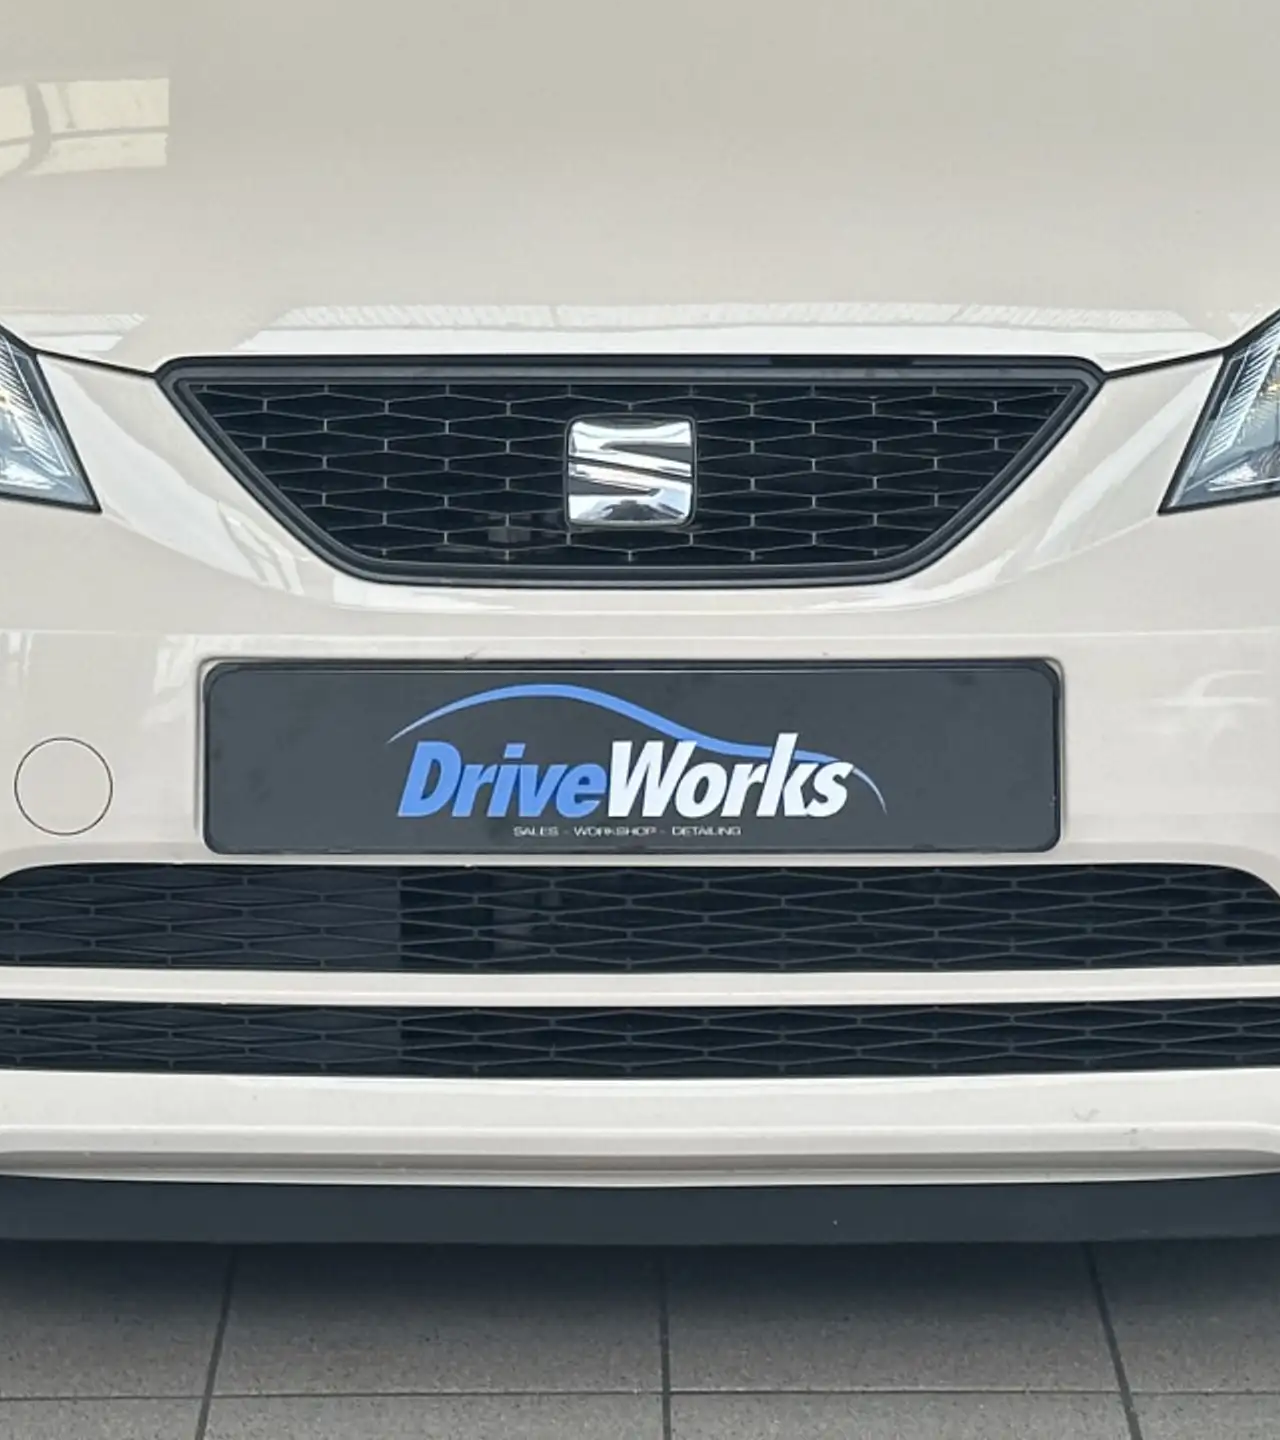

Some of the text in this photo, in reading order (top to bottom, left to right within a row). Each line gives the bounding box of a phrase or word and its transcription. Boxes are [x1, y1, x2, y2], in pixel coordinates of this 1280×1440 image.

[397, 733, 854, 818] DriveWorks
[513, 825, 741, 837] SALES WORKSHOP DETAILING
